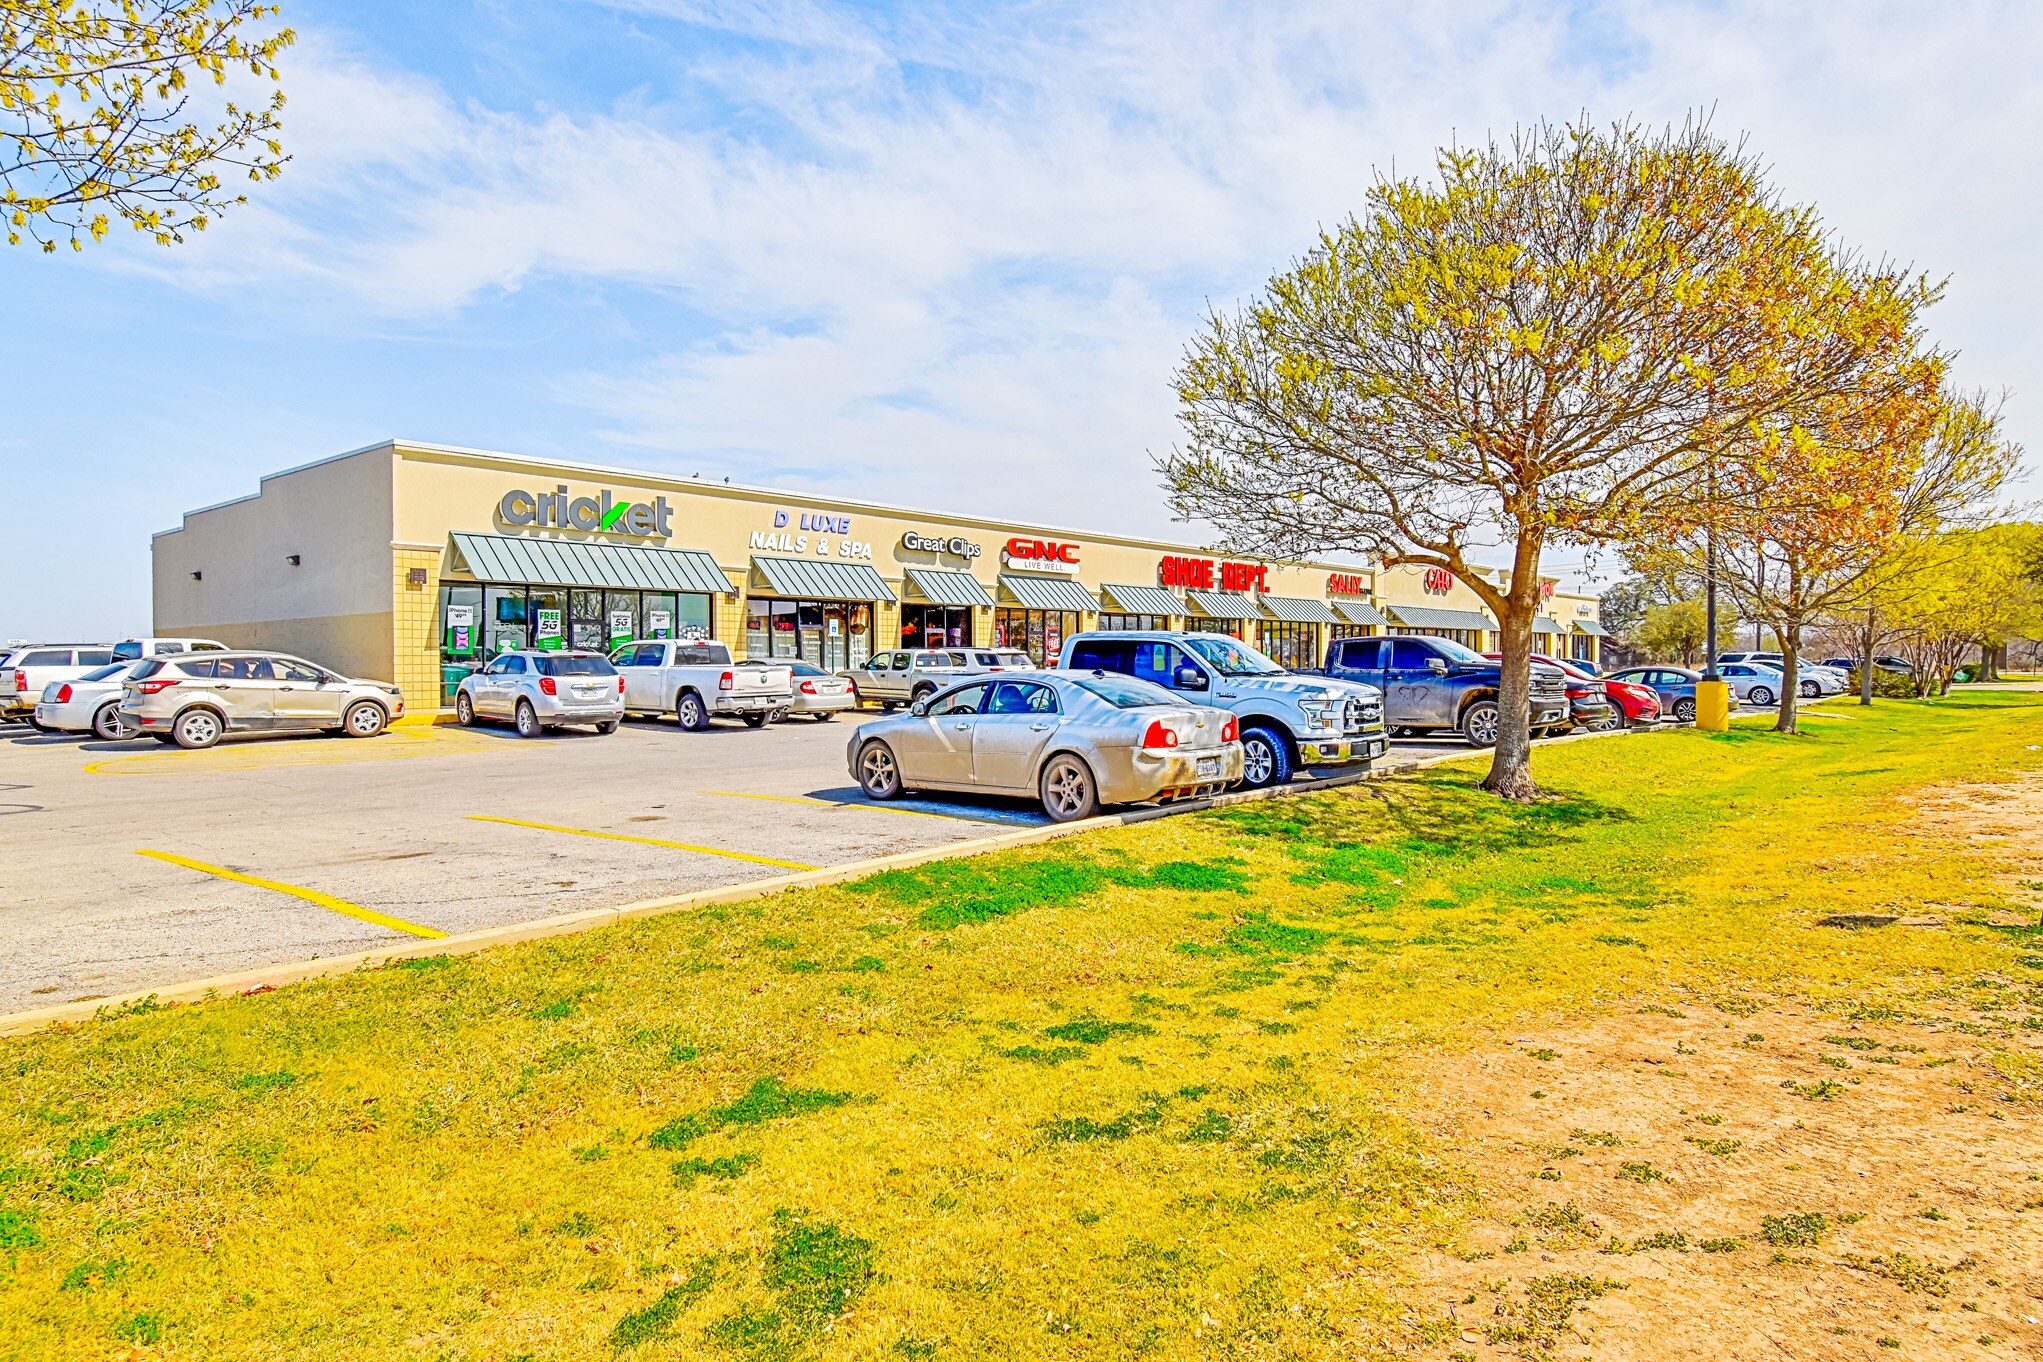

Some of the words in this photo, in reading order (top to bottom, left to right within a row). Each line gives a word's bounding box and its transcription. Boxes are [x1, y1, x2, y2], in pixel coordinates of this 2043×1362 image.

[501, 485, 673, 537] cricket
[774, 510, 789, 528] D
[800, 513, 850, 534] LUXE
[749, 531, 807, 553] NAILS
[817, 538, 828, 555] &
[839, 540, 872, 559] SPA
[902, 531, 946, 552] Great
[947, 537, 981, 559] Clips
[1007, 538, 1080, 563] GNC
[1024, 561, 1042, 570] LIVE
[1162, 556, 1214, 588] SHOE
[1221, 561, 1271, 593] DEPT.
[1330, 573, 1363, 595] SALLY
[1427, 568, 1454, 591] CATO
[539, 611, 559, 620] FREE
[541, 620, 558, 630] 5G
[615, 618, 628, 626] 5G
